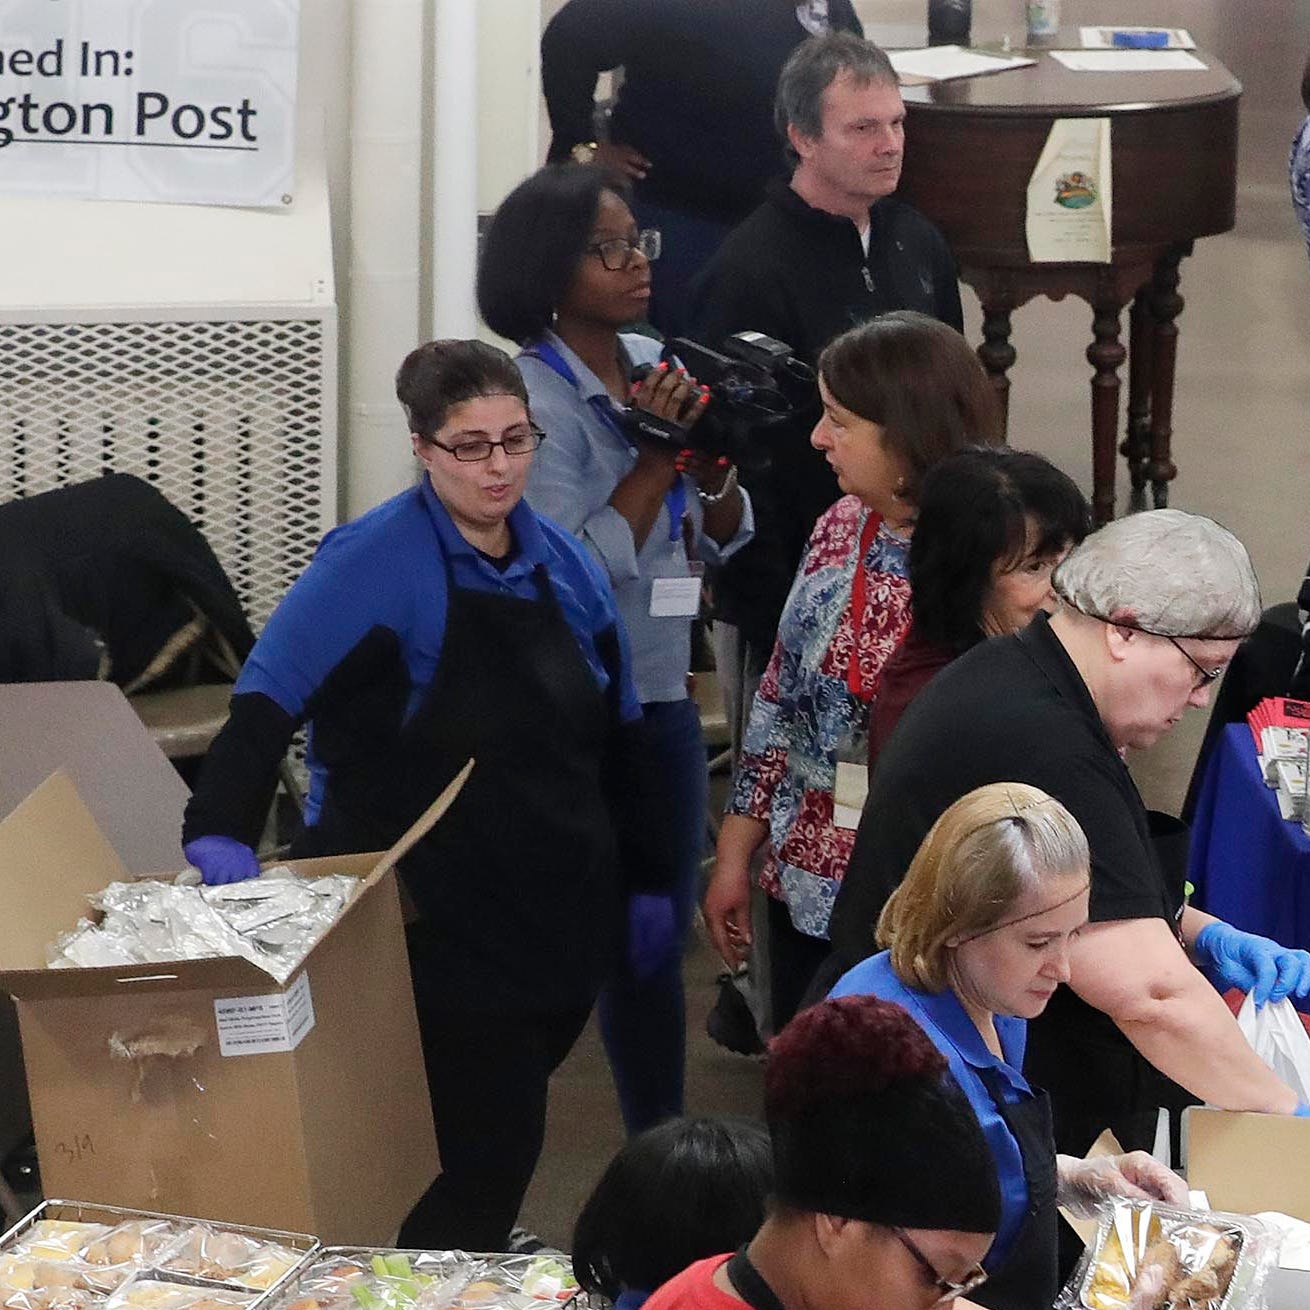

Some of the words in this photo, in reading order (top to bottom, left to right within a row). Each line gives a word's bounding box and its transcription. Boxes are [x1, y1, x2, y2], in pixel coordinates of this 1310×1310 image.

[0, 39, 63, 77] ed
[80, 41, 134, 77] In:
[135, 92, 258, 142] Post
